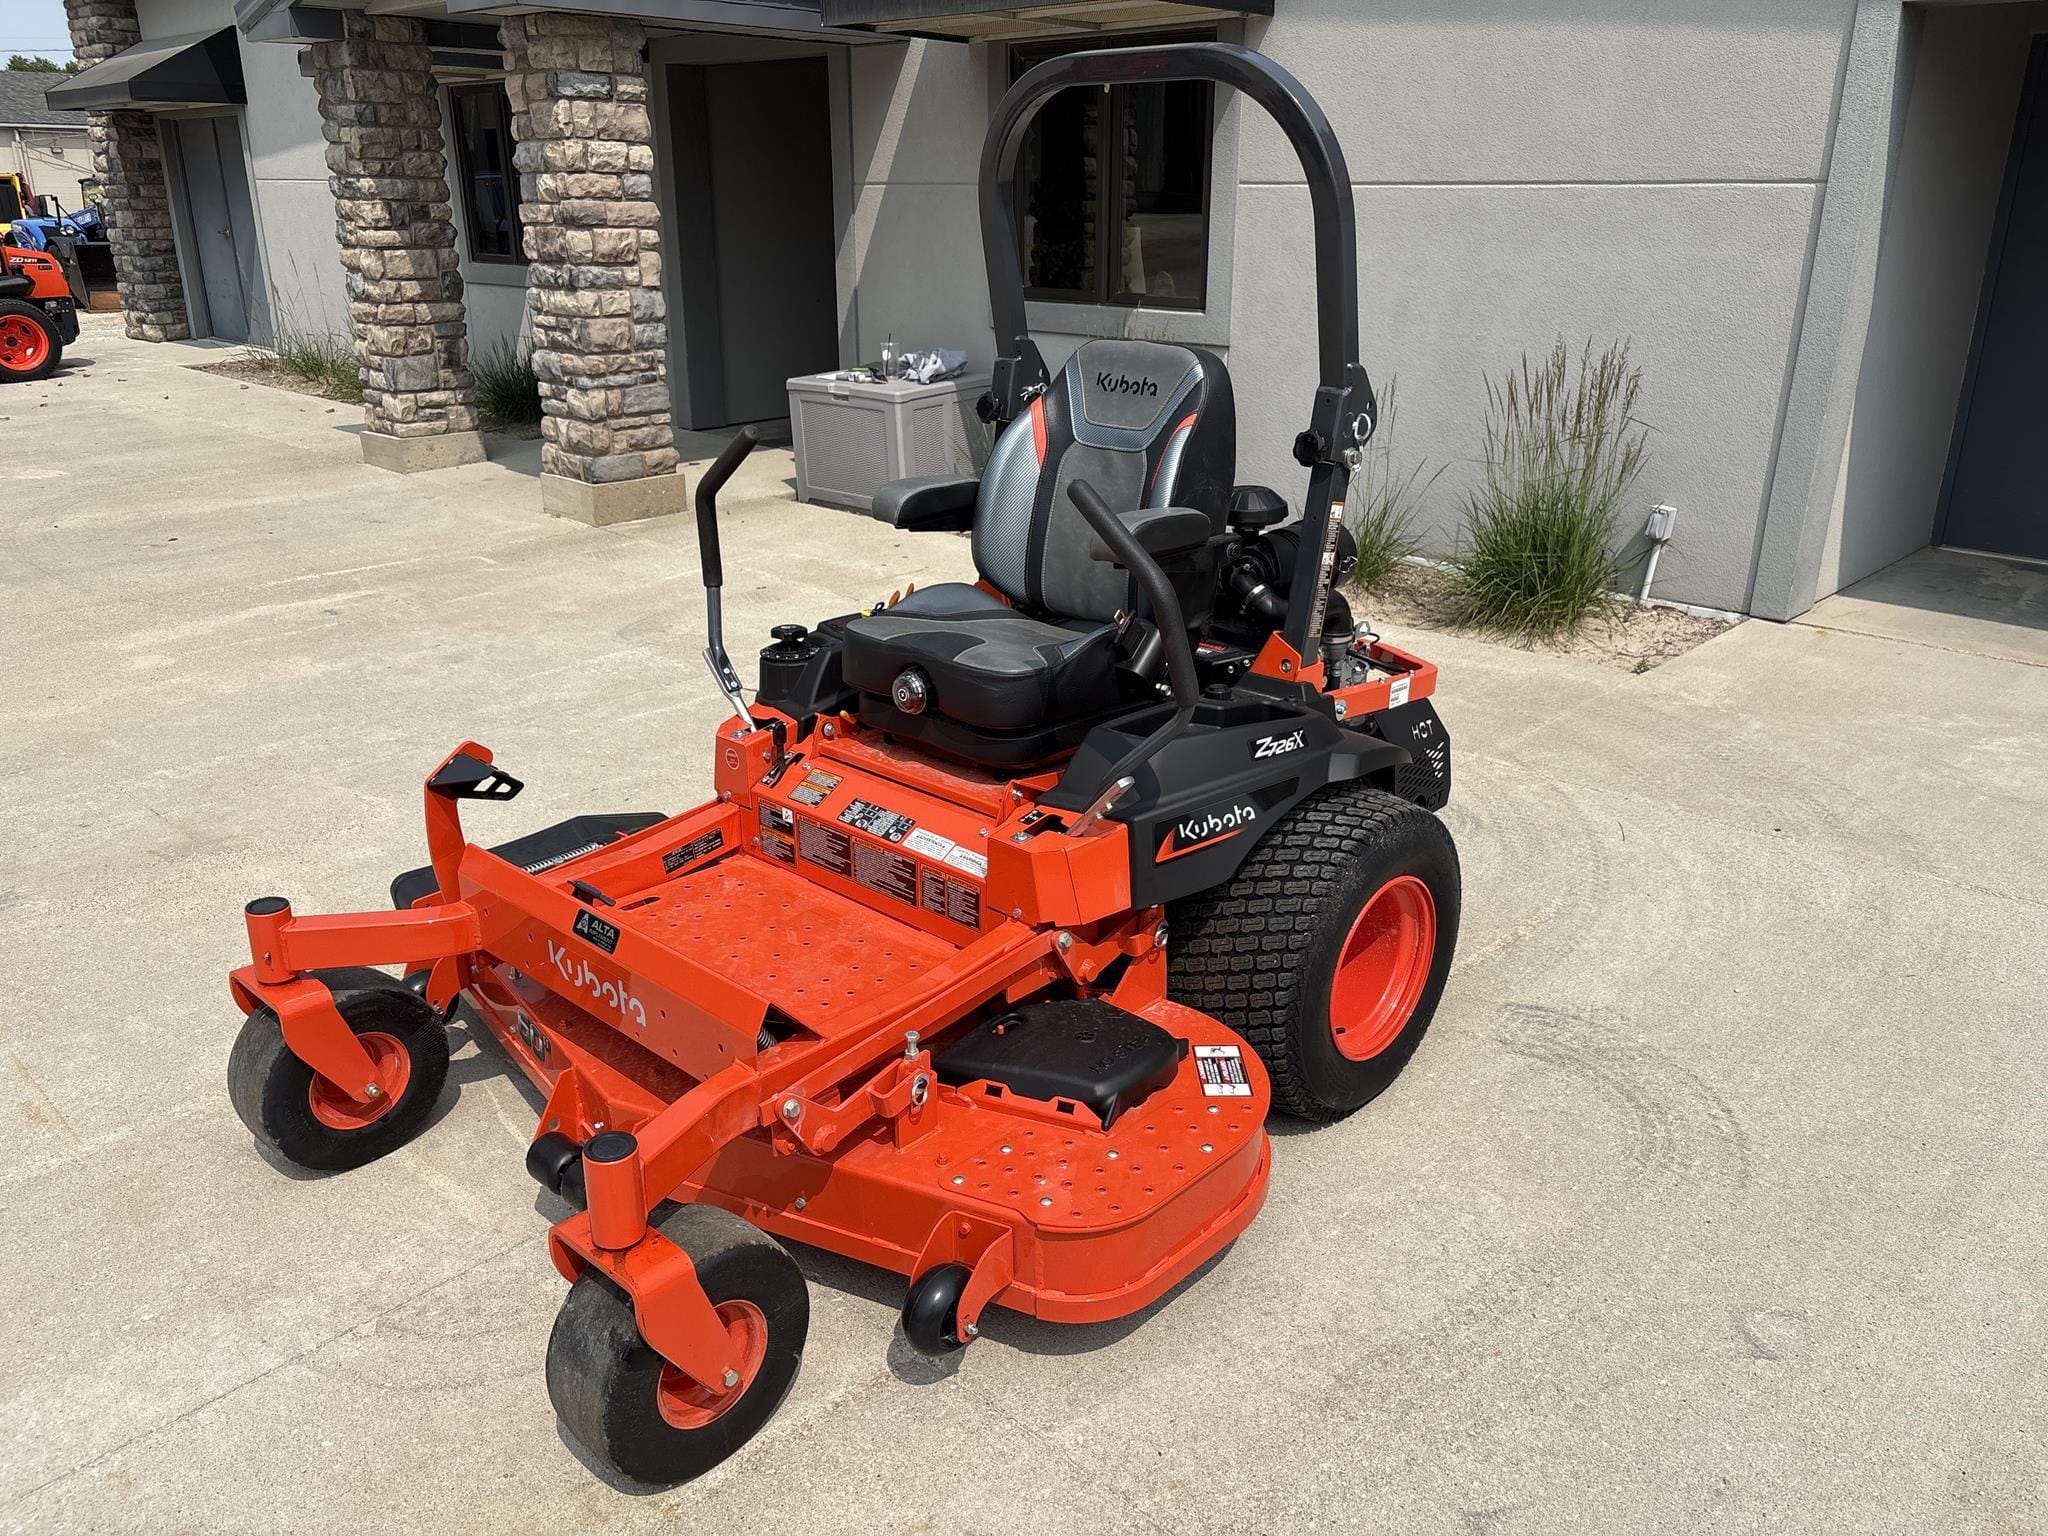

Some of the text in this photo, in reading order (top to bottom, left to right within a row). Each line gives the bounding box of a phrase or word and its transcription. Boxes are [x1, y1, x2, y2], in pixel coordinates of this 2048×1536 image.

[1096, 371, 1158, 396] Kubota
[1411, 719, 1433, 740] HOT
[1254, 729, 1305, 759] Z726X
[1178, 804, 1257, 840] Kubota
[591, 920, 615, 940] ALTA
[547, 938, 647, 1028] Kubota
